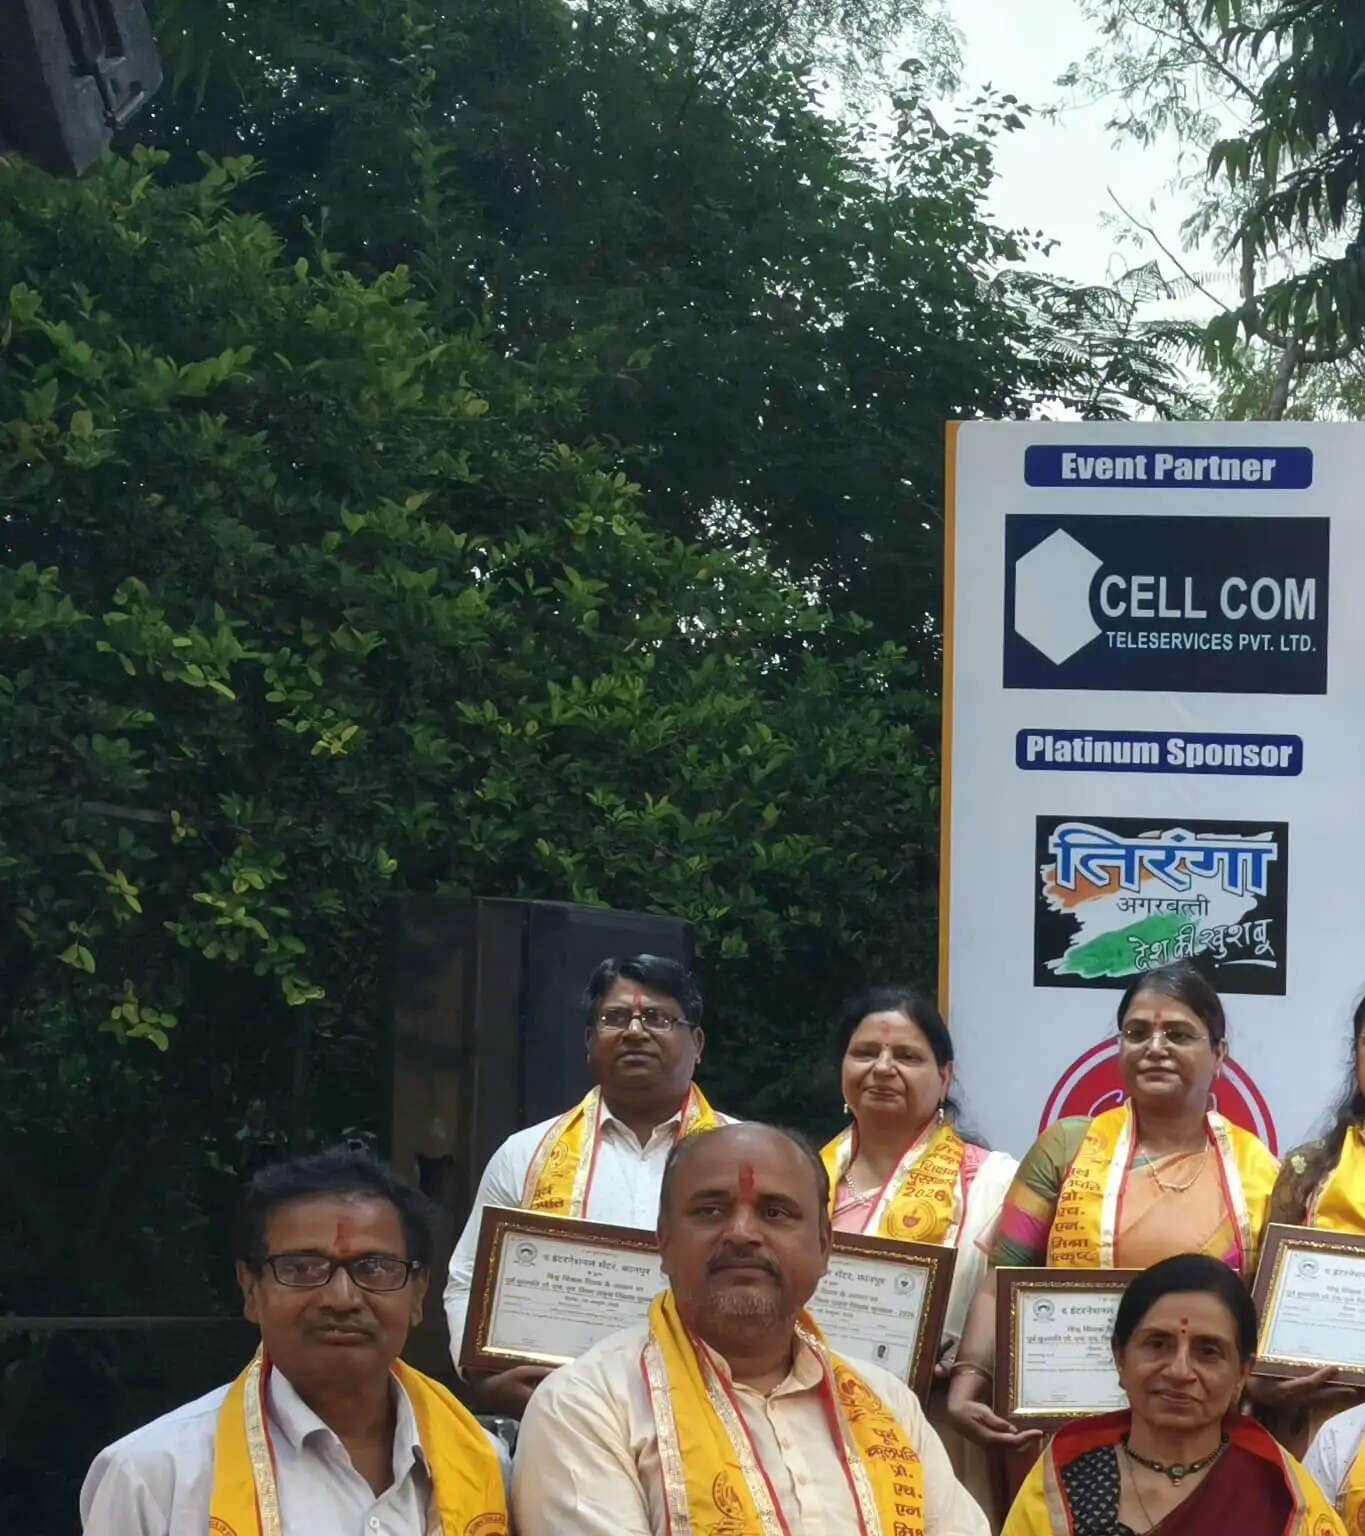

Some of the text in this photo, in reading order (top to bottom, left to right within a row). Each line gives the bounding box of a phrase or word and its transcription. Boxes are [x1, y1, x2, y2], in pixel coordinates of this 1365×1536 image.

[1062, 453, 1276, 482] Event Partner
[1100, 575, 1316, 620] CELL COM
[1107, 632, 1316, 652] TELESERVICES PVT. LTD.
[1027, 736, 1293, 768] Platinum Sponsor
[1050, 823, 1278, 896] तिरंगा
[1116, 898, 1210, 918] अगरबत्ती
